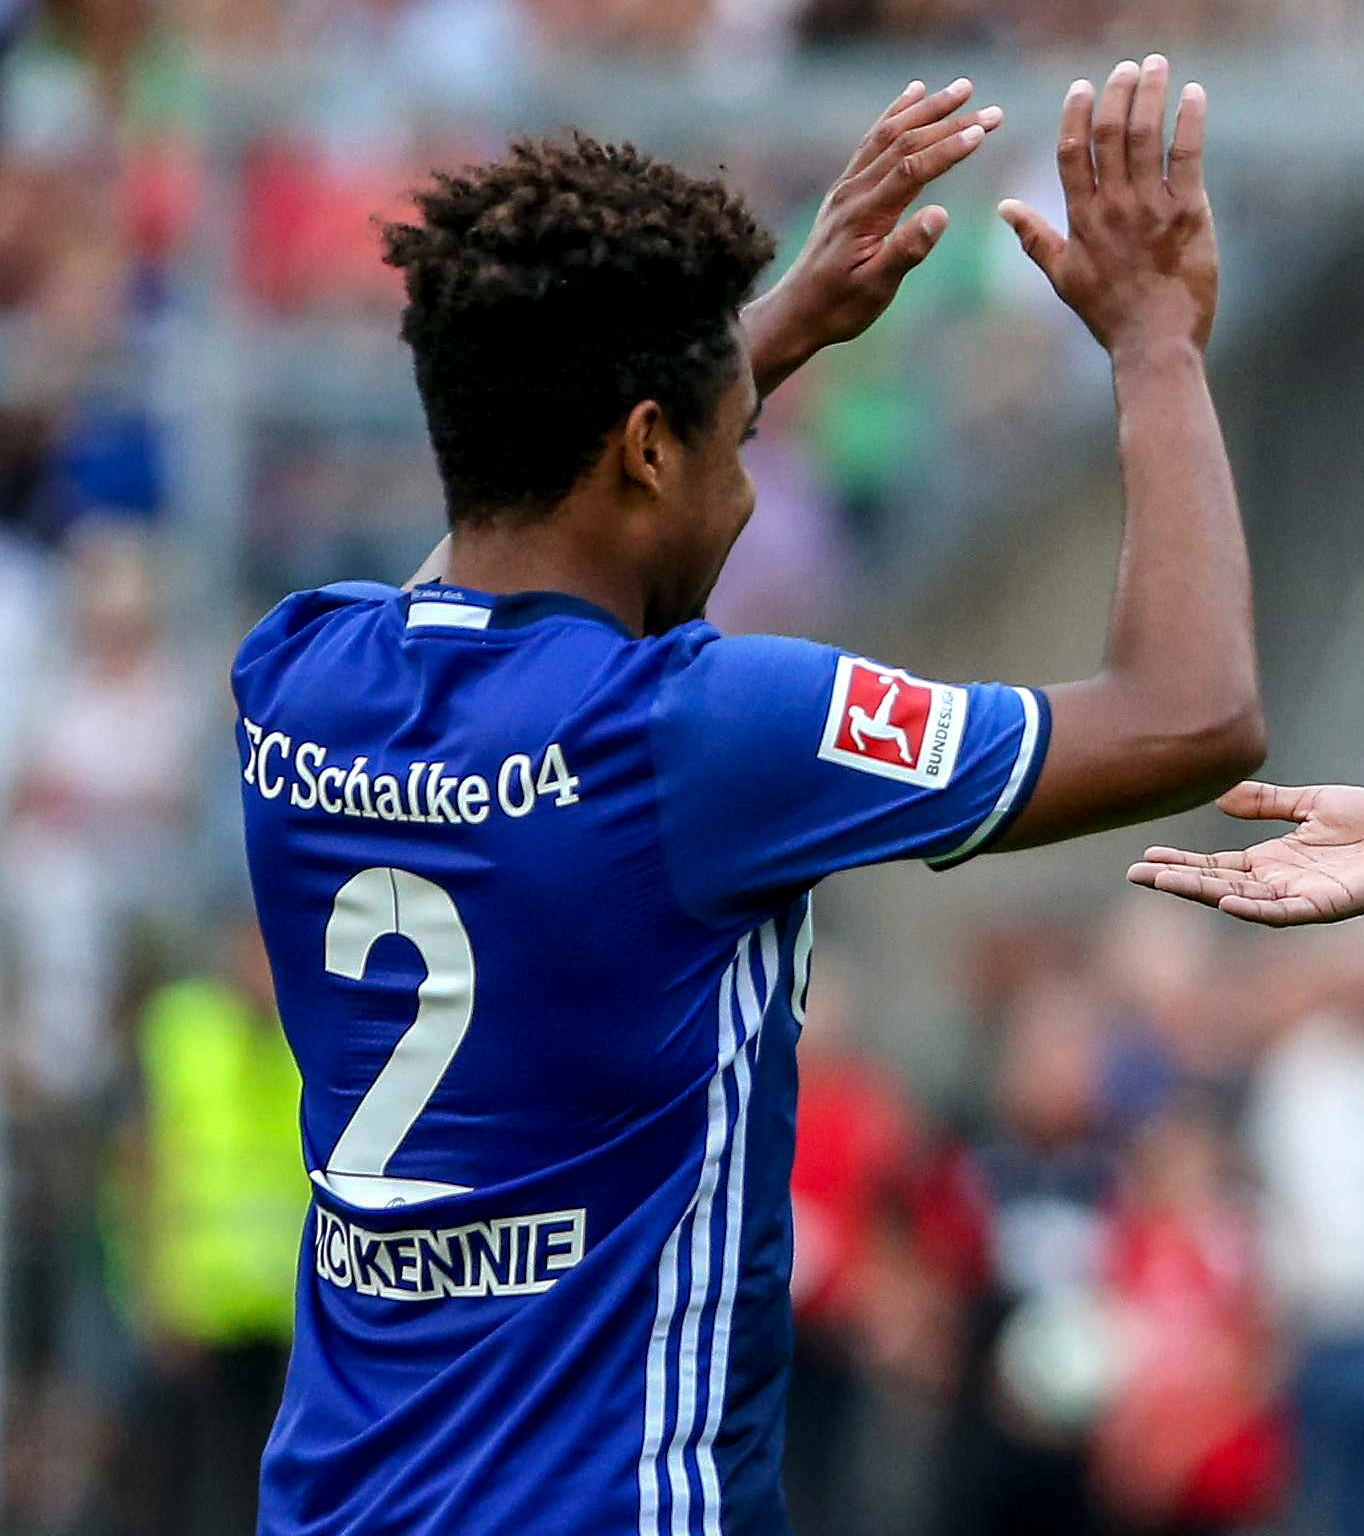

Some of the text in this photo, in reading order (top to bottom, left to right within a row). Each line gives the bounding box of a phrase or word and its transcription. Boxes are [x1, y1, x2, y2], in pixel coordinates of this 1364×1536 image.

[290, 742, 490, 824] Schalke
[499, 743, 580, 818] 04
[309, 867, 475, 1210] 2
